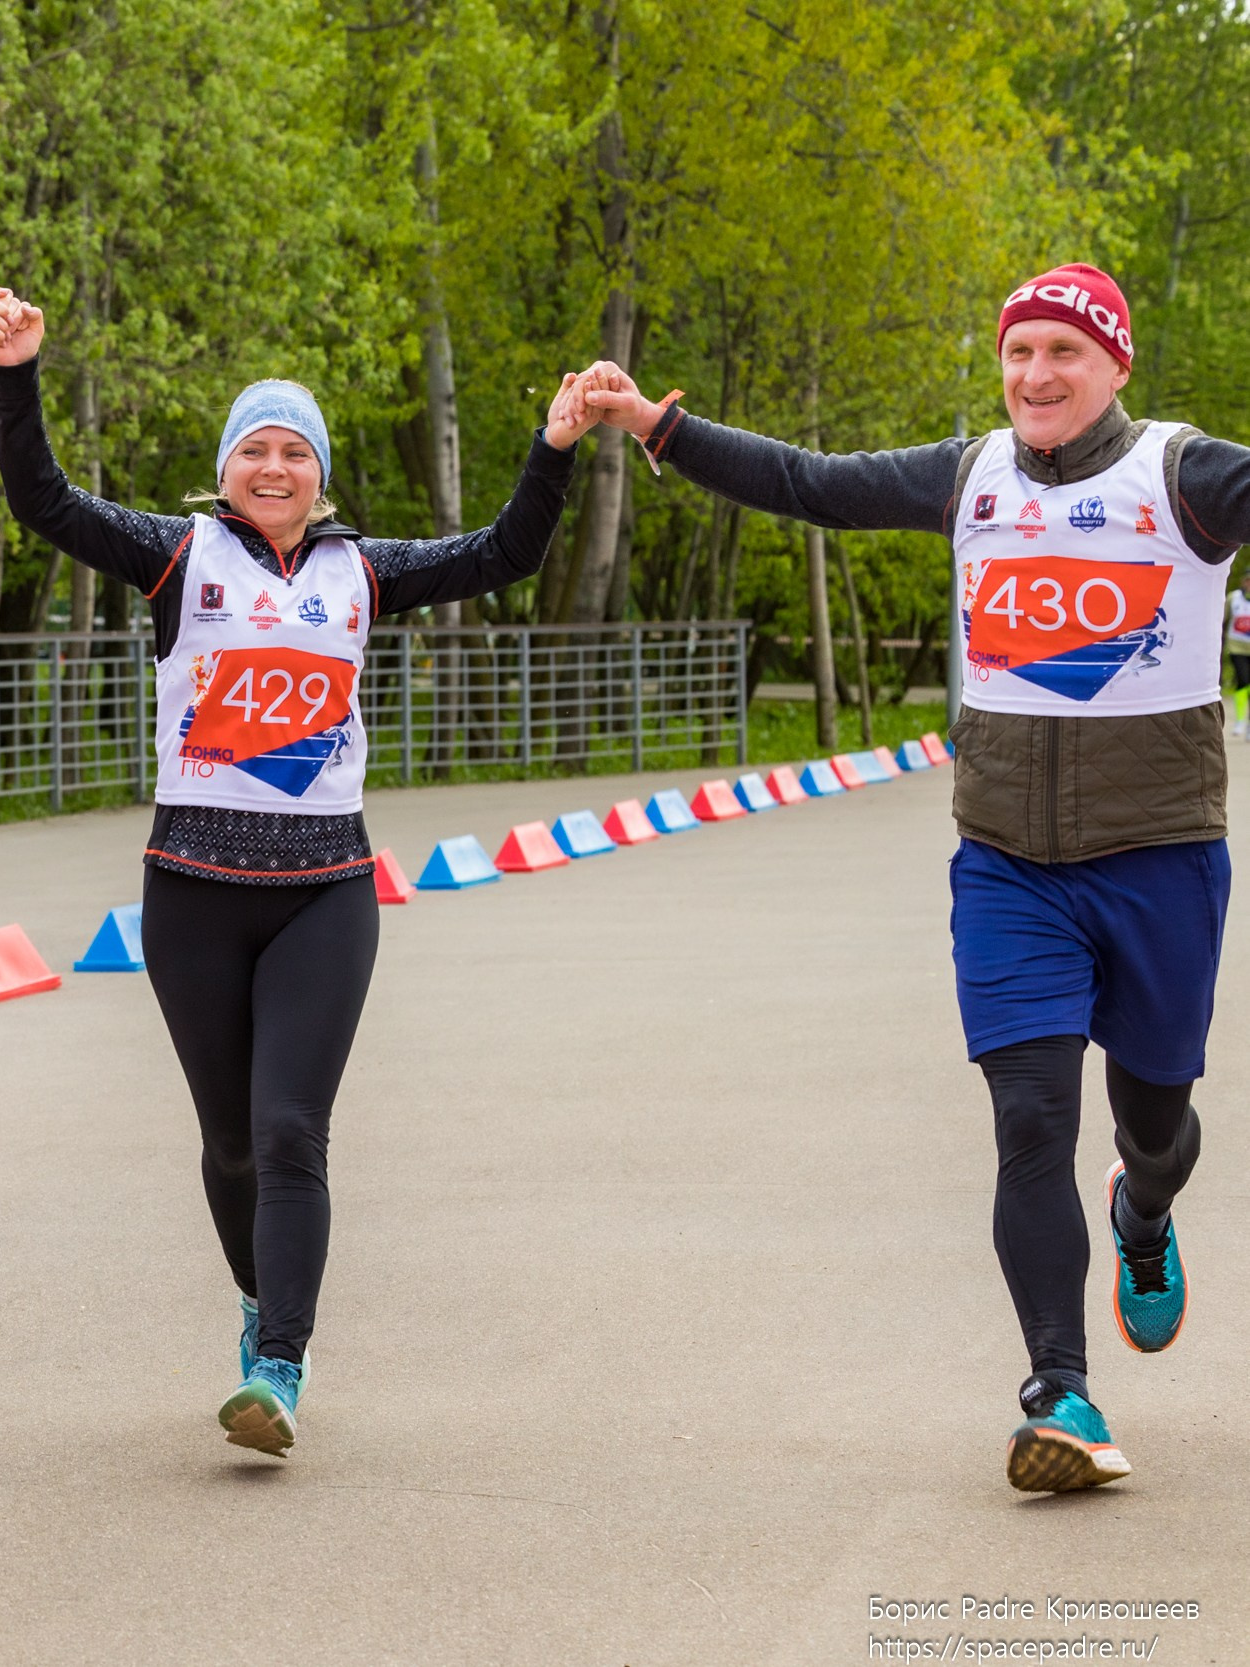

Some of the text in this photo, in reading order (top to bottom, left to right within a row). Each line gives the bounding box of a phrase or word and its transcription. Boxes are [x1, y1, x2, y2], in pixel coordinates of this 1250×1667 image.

[984, 576, 1127, 633] 430
[221, 668, 331, 725] 429
[181, 760, 214, 778] ГТО
